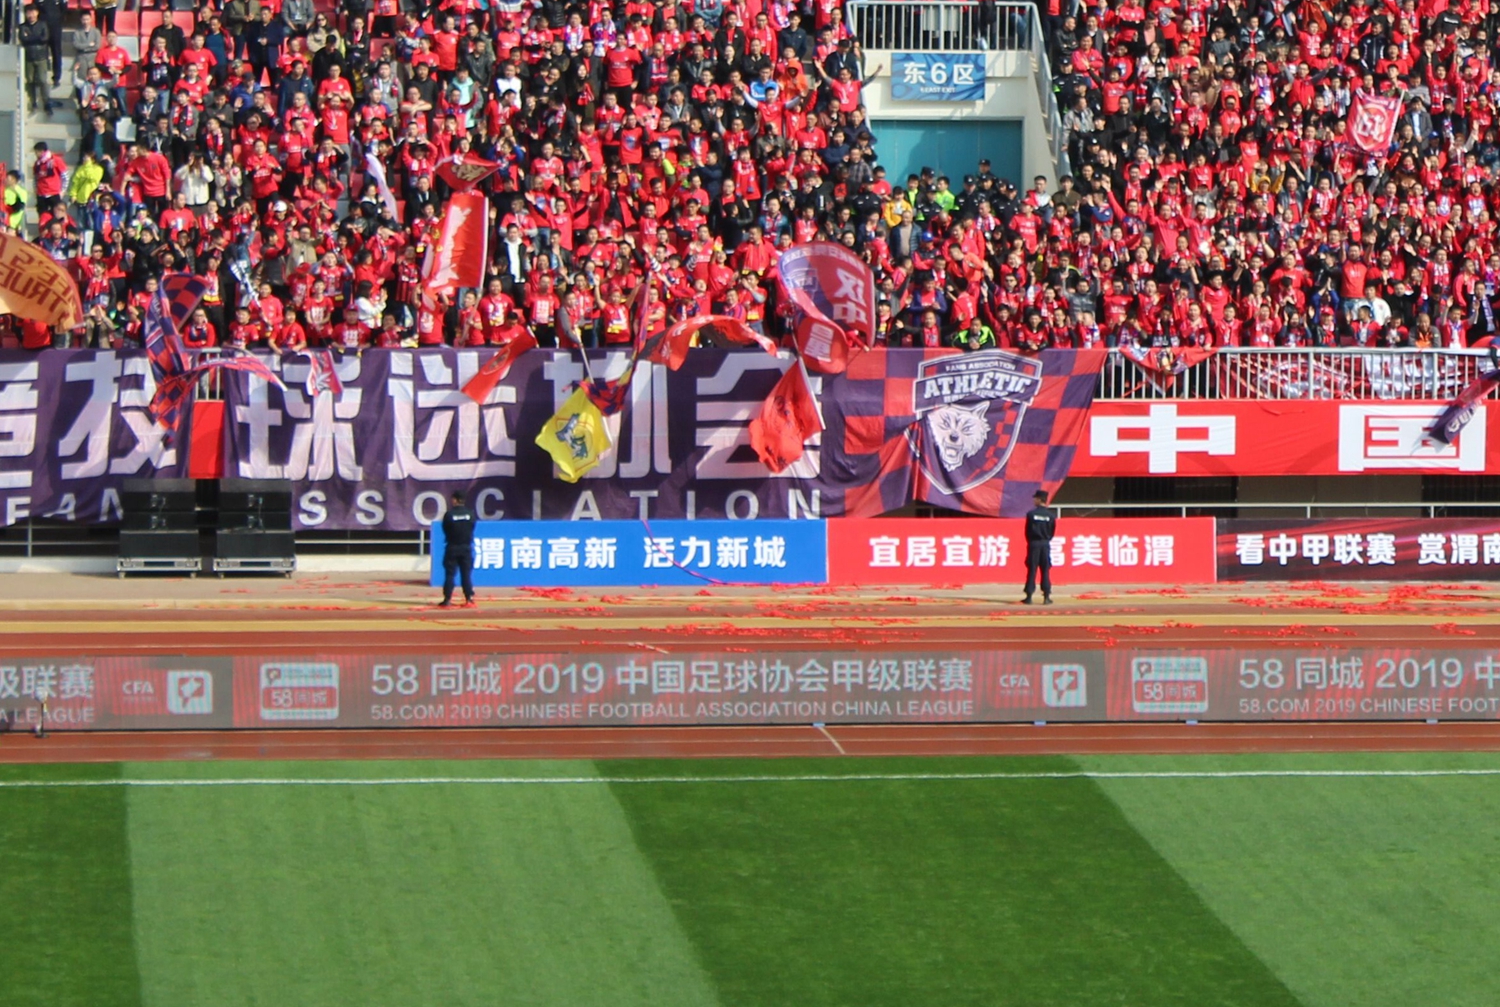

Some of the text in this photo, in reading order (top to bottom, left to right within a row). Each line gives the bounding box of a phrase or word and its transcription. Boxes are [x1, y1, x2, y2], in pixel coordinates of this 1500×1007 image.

[903, 61, 974, 85] 东6区
[924, 372, 1032, 399] ATHLETIC
[299, 488, 821, 527] SSOCIATION
[473, 536, 787, 570] 渭南高新 活力新城
[869, 535, 1010, 568] 宜居宜游
[1236, 533, 1395, 566] 看中甲联赛
[122, 680, 154, 695] CFA
[371, 659, 972, 695] 58 同城 2019 中国足球协会甲级联赛
[1000, 675, 1030, 688] CFA
[1239, 658, 1285, 689] 58
[1296, 656, 1364, 690] 同城
[1375, 658, 1463, 689] 2019
[371, 700, 974, 720] 58.COM 2019 CHINESE FOOTBALL ASSOCIATION CHINA LEAGUE
[1239, 698, 1309, 713] 58.COM
[1315, 698, 1356, 713] 2019
[1360, 698, 1442, 713] CHINESE
